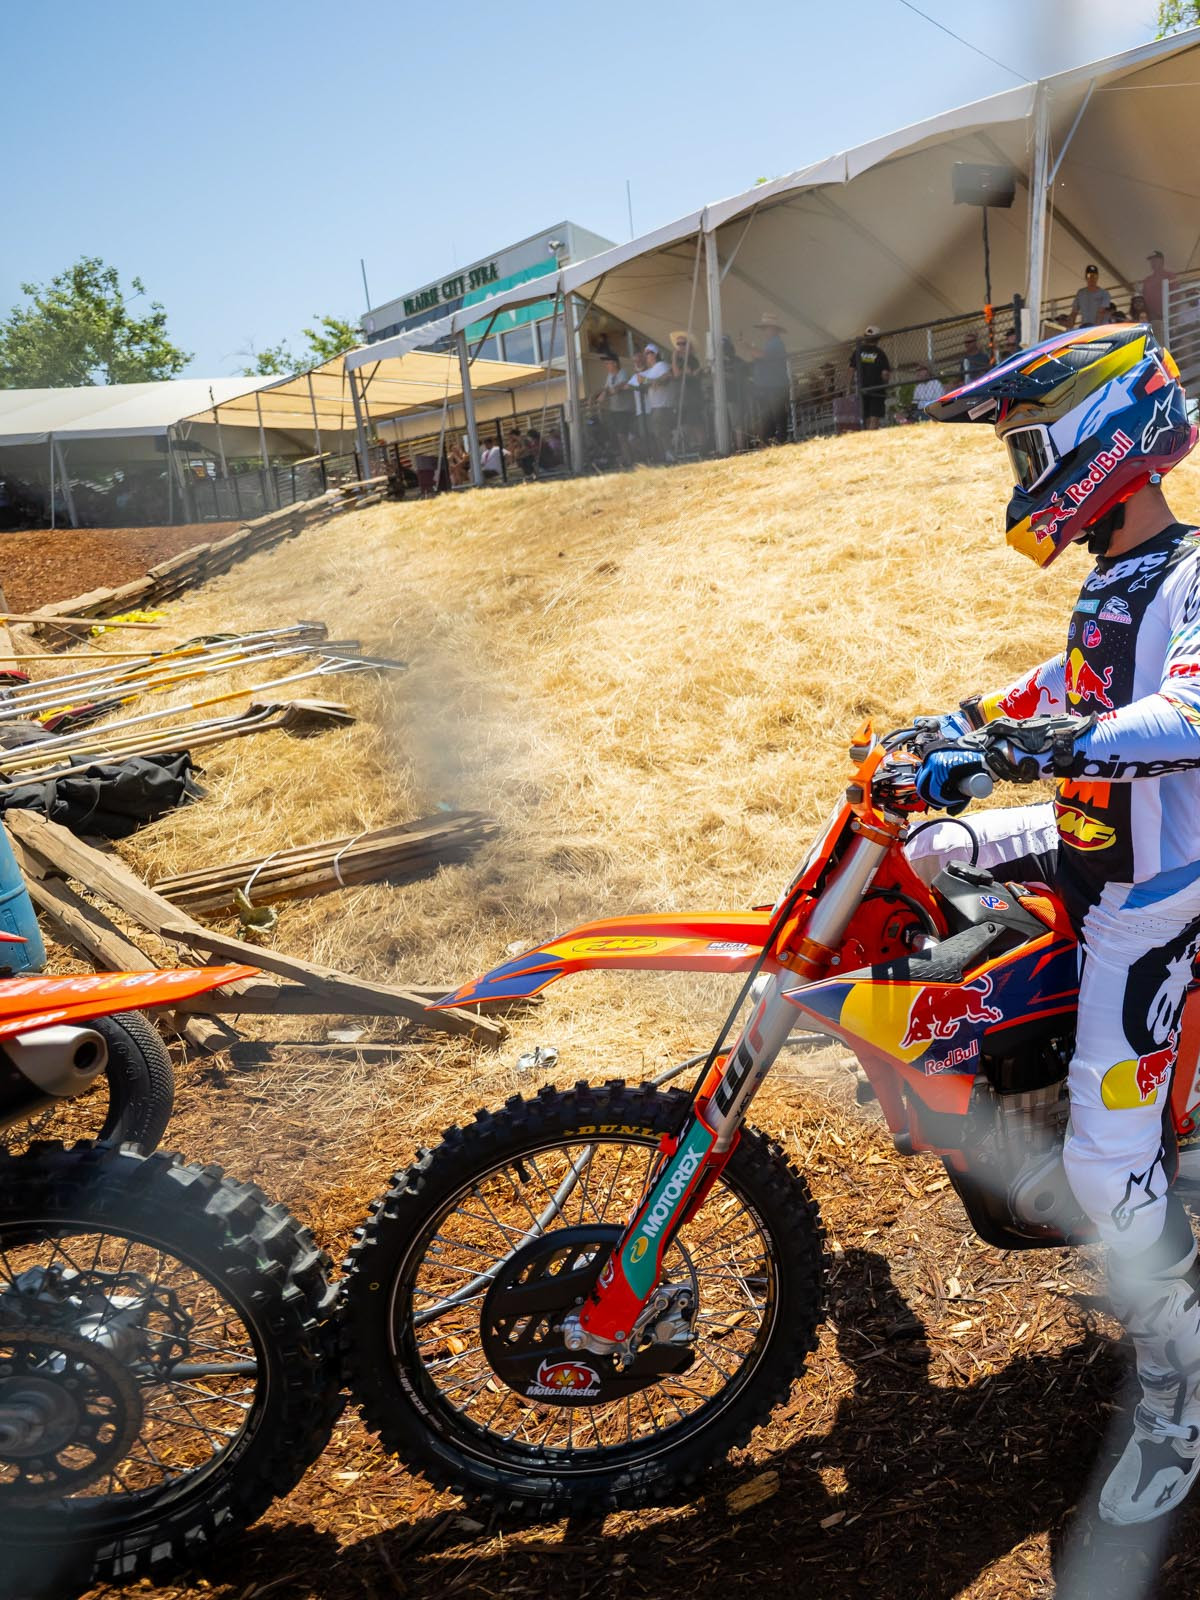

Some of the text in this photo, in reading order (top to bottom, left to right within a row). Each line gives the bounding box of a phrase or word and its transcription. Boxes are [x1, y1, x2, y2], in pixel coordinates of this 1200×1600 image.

[441, 275, 465, 300] CITY
[1065, 429, 1136, 506] Red Bull
[925, 1039, 980, 1076] Red Bull
[578, 1124, 666, 1139] DUNL
[642, 1146, 705, 1239] MOTOREX
